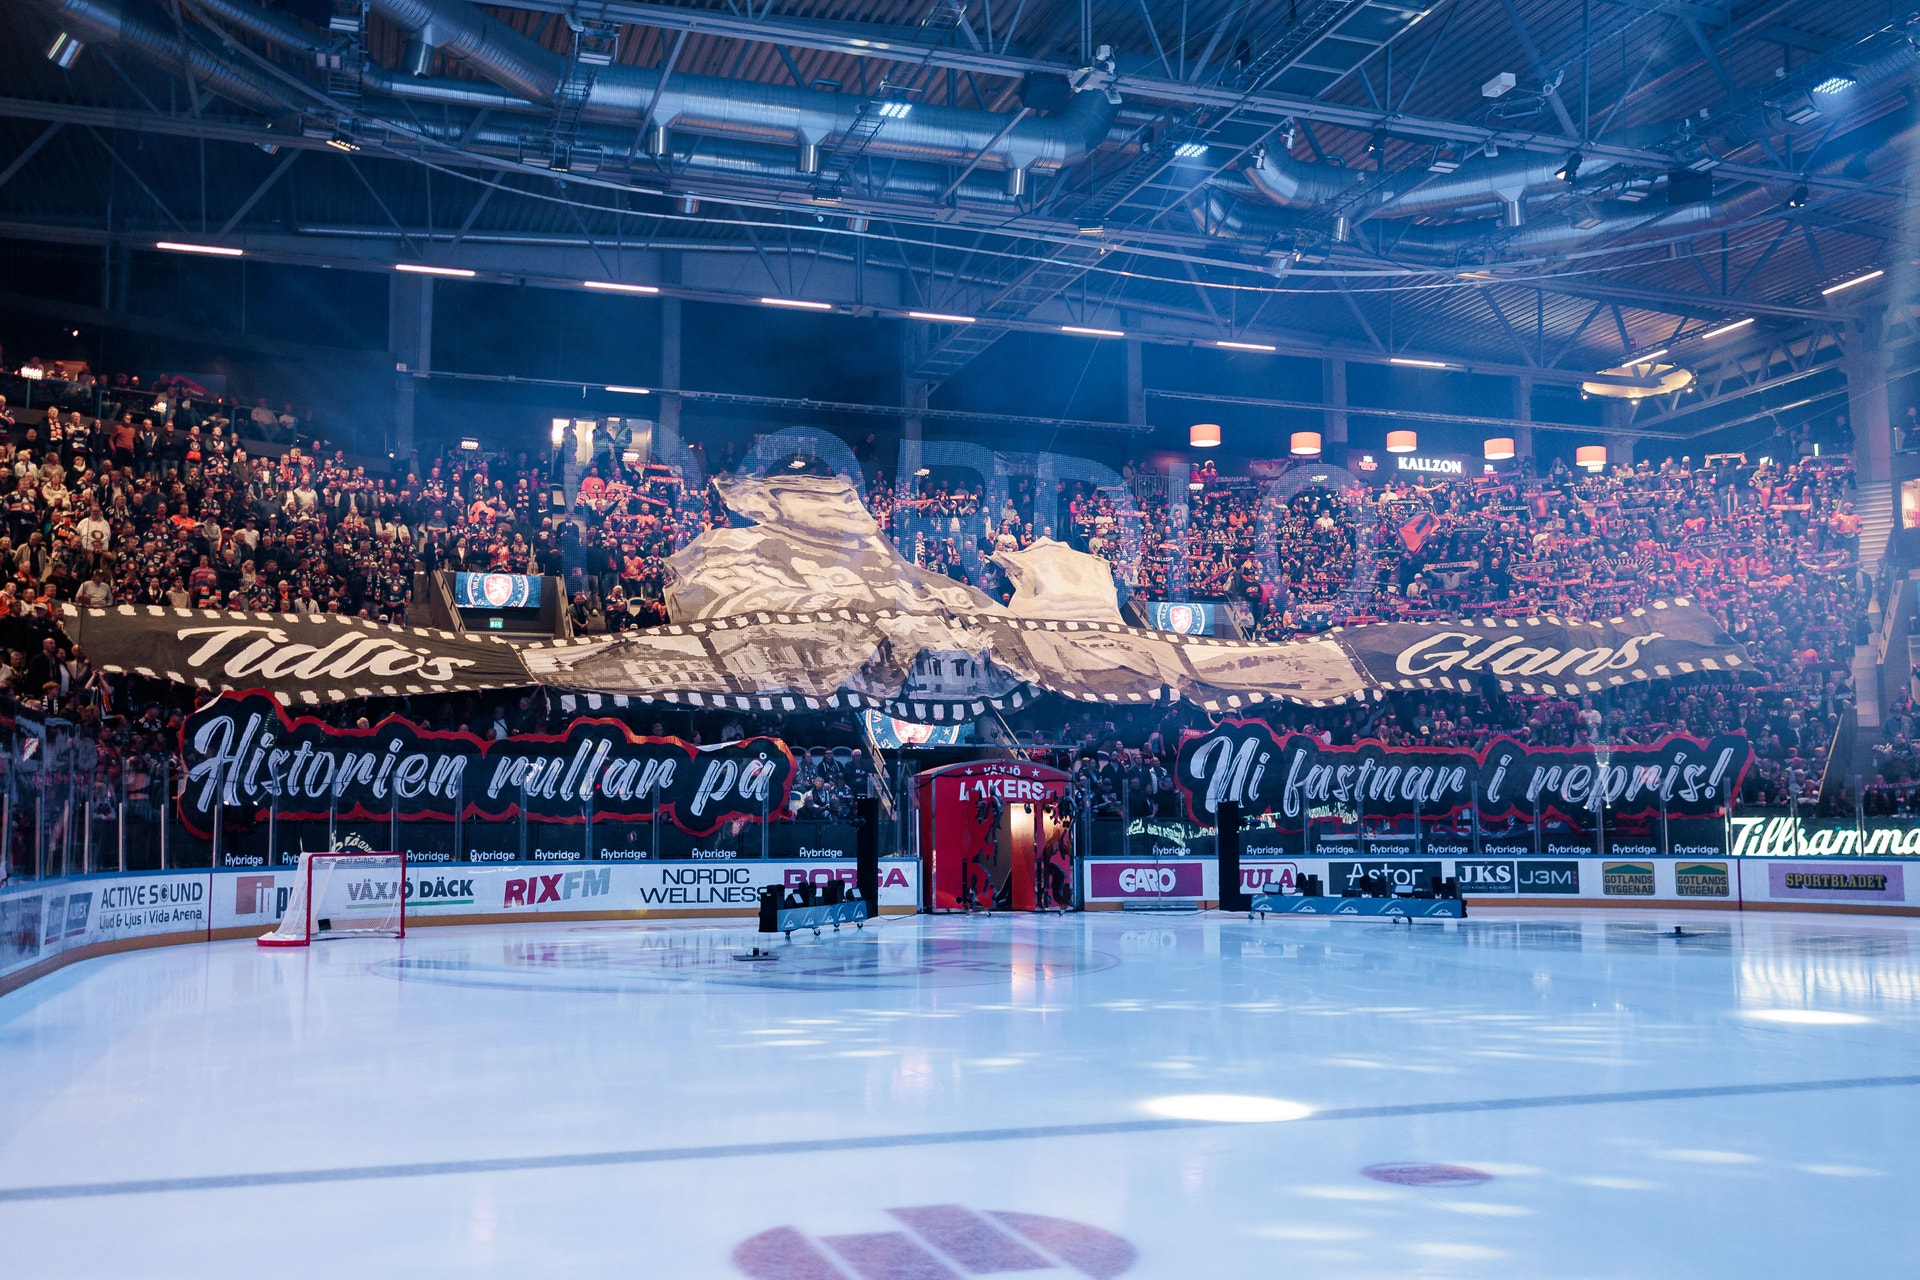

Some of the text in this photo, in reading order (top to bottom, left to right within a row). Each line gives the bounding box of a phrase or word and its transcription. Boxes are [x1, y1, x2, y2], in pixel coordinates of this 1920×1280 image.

[1397, 456, 1462, 474] KALLZON
[177, 625, 476, 681] Tidlös
[1396, 632, 1665, 675] Glans
[188, 712, 777, 816] Historien rullar på
[983, 764, 1021, 776] VÄXJÖ
[1189, 736, 1734, 818] Ni fastnar i repris!
[958, 779, 1045, 801] LAKERS
[470, 849, 515, 862] Hybridge
[534, 848, 581, 861] Hybridge
[600, 847, 647, 860] Hybridge
[691, 847, 737, 860] Hybridge
[799, 847, 843, 858] Hybridge
[1246, 845, 1284, 856] Hybridge
[1316, 844, 1354, 855] Hybridge
[1370, 844, 1410, 855] Hybridge
[1427, 844, 1469, 855] Hybridge
[1485, 843, 1528, 855] Hybridge
[1548, 843, 1592, 855] Hybridge
[1612, 843, 1657, 855] Hybridge
[1674, 843, 1719, 855] Hybridge
[225, 853, 263, 867] Hybridge
[405, 850, 450, 862] Hybridge
[662, 868, 750, 885] NORDIC
[784, 868, 909, 888] BORA
[1118, 868, 1177, 893] GARO
[1459, 865, 1512, 883] JKS
[1519, 870, 1572, 884] J3M
[1604, 875, 1653, 884] GOTLANDS
[1677, 875, 1727, 885] GOTLANDS
[419, 876, 475, 898] DÄCK
[1785, 873, 1886, 891] SPORTBLADET
[101, 886, 146, 909] ACTIVE
[99, 914, 114, 932] Ljud
[116, 916, 123, 926] &
[125, 914, 142, 929] Ljus
[149, 910, 169, 923] Vida
[172, 908, 202, 921] Arena
